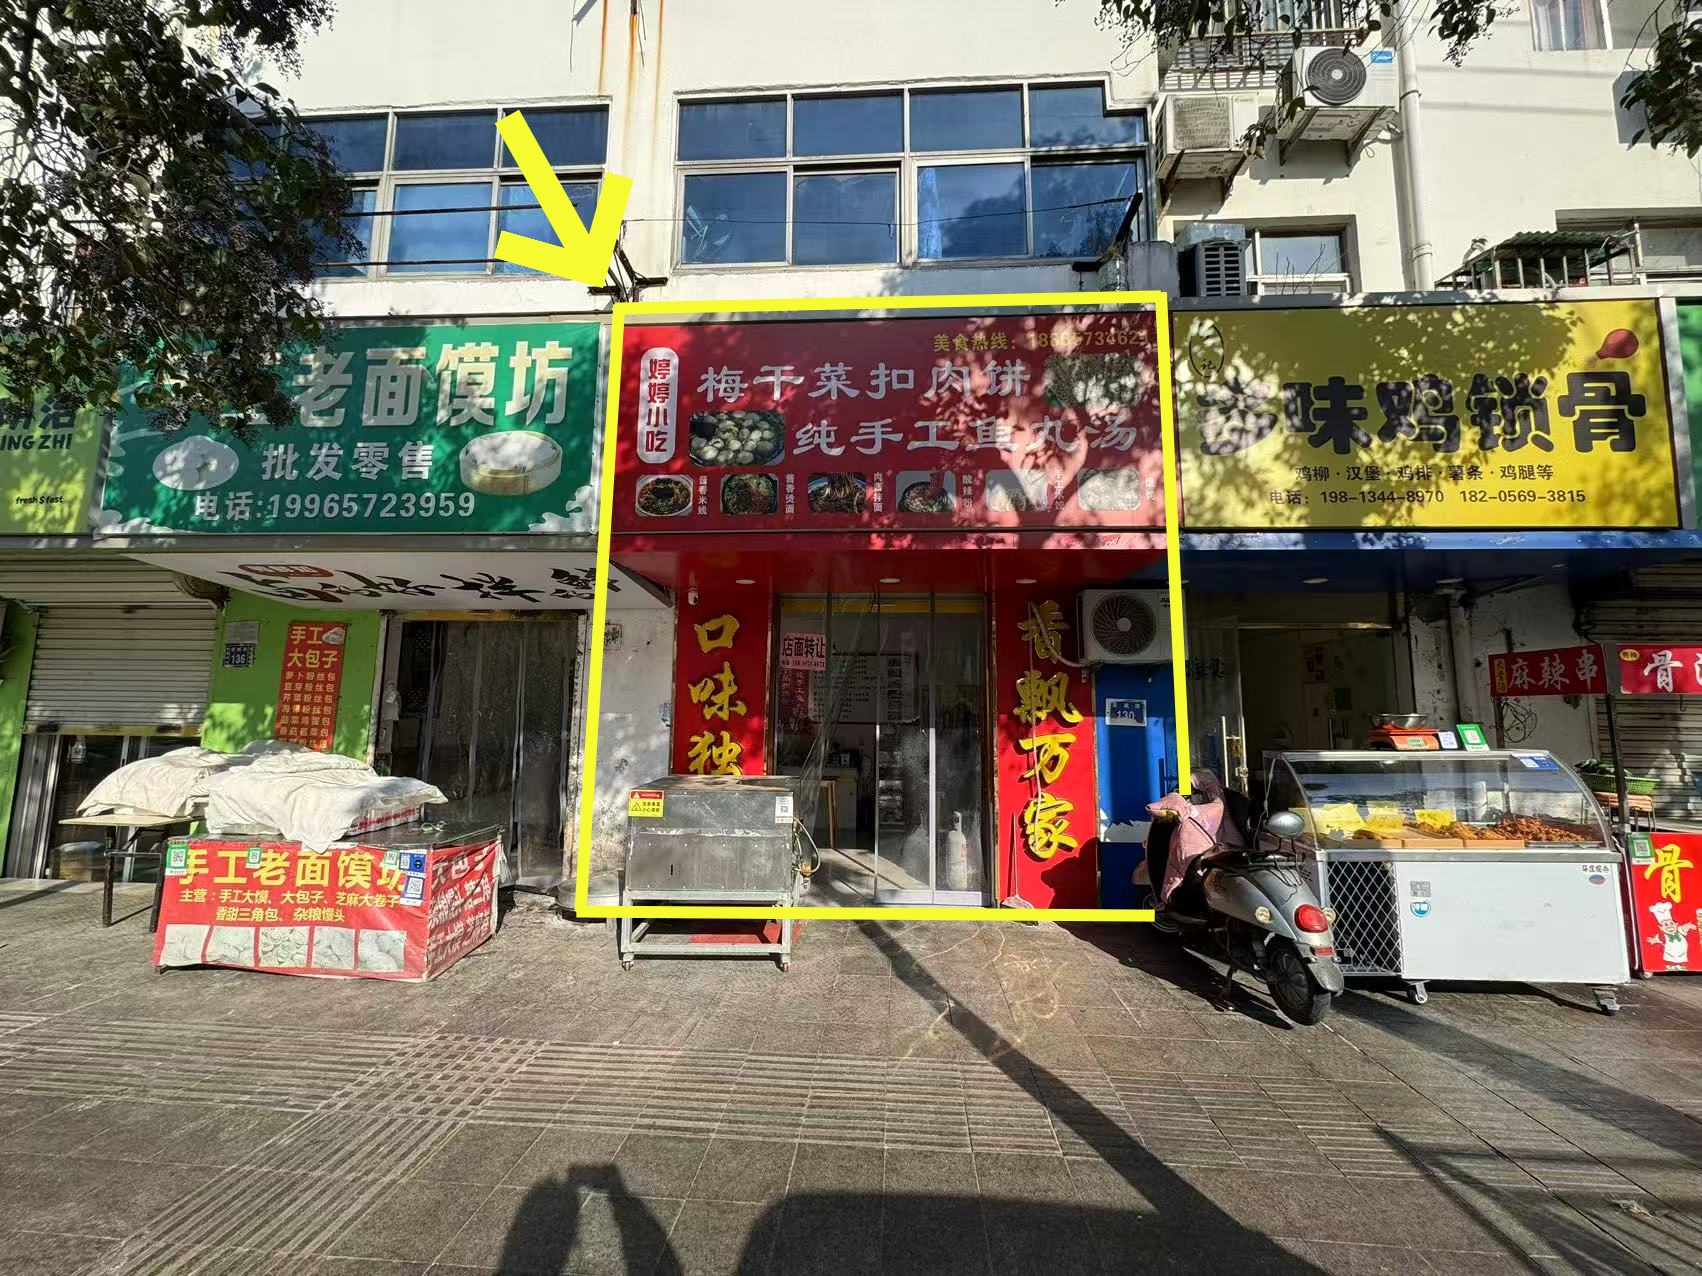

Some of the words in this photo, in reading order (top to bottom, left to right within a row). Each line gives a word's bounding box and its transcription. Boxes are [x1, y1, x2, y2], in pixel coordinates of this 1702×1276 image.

[150, 338, 573, 428] 老面馍坊
[697, 360, 1032, 403] 梅干菜扣肉饼
[646, 358, 671, 453] 婷婷小吃
[38, 433, 73, 450] ZHI
[793, 414, 1139, 457] 纯手工鱼丸汤
[261, 441, 436, 481] 批发零售
[1459, 488, 1586, 504] 182-0569-3815
[291, 626, 323, 645] 手工
[782, 637, 826, 658] 店面转让
[287, 648, 338, 669] 大包子
[1508, 649, 1599, 691] 麻辣串
[1643, 650, 1702, 693] 骨
[688, 614, 747, 776] 口味独
[1014, 600, 1085, 858] 香飘万家
[1643, 843, 1694, 904] 骨
